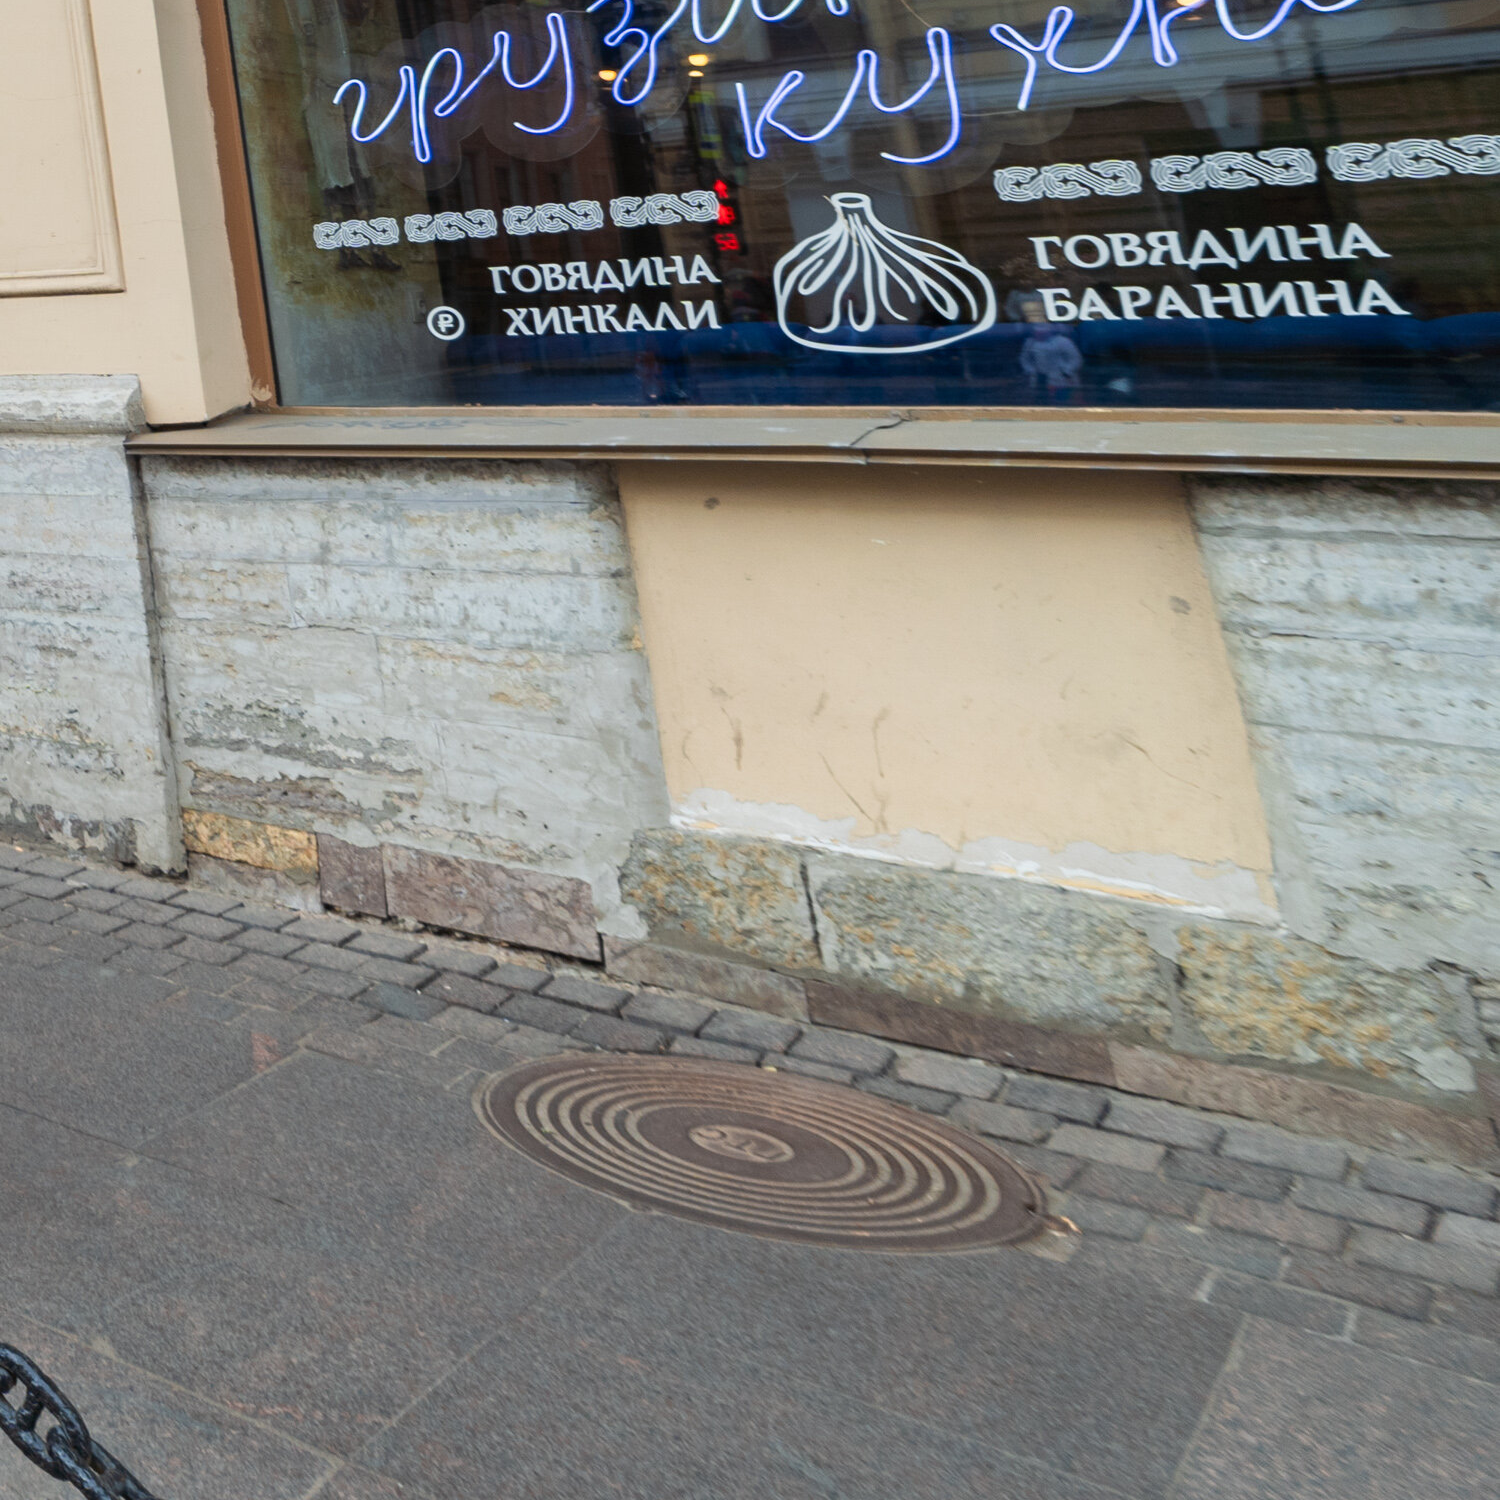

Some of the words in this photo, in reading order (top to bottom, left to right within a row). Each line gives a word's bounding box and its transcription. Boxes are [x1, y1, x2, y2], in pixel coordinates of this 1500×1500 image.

[1029, 222, 1391, 270] ГОВЯДИНА
[489, 254, 722, 294] ГОВЯДИНА
[503, 299, 722, 337] ХИНКАЛИ
[1038, 278, 1412, 322] БАРАНИНА
